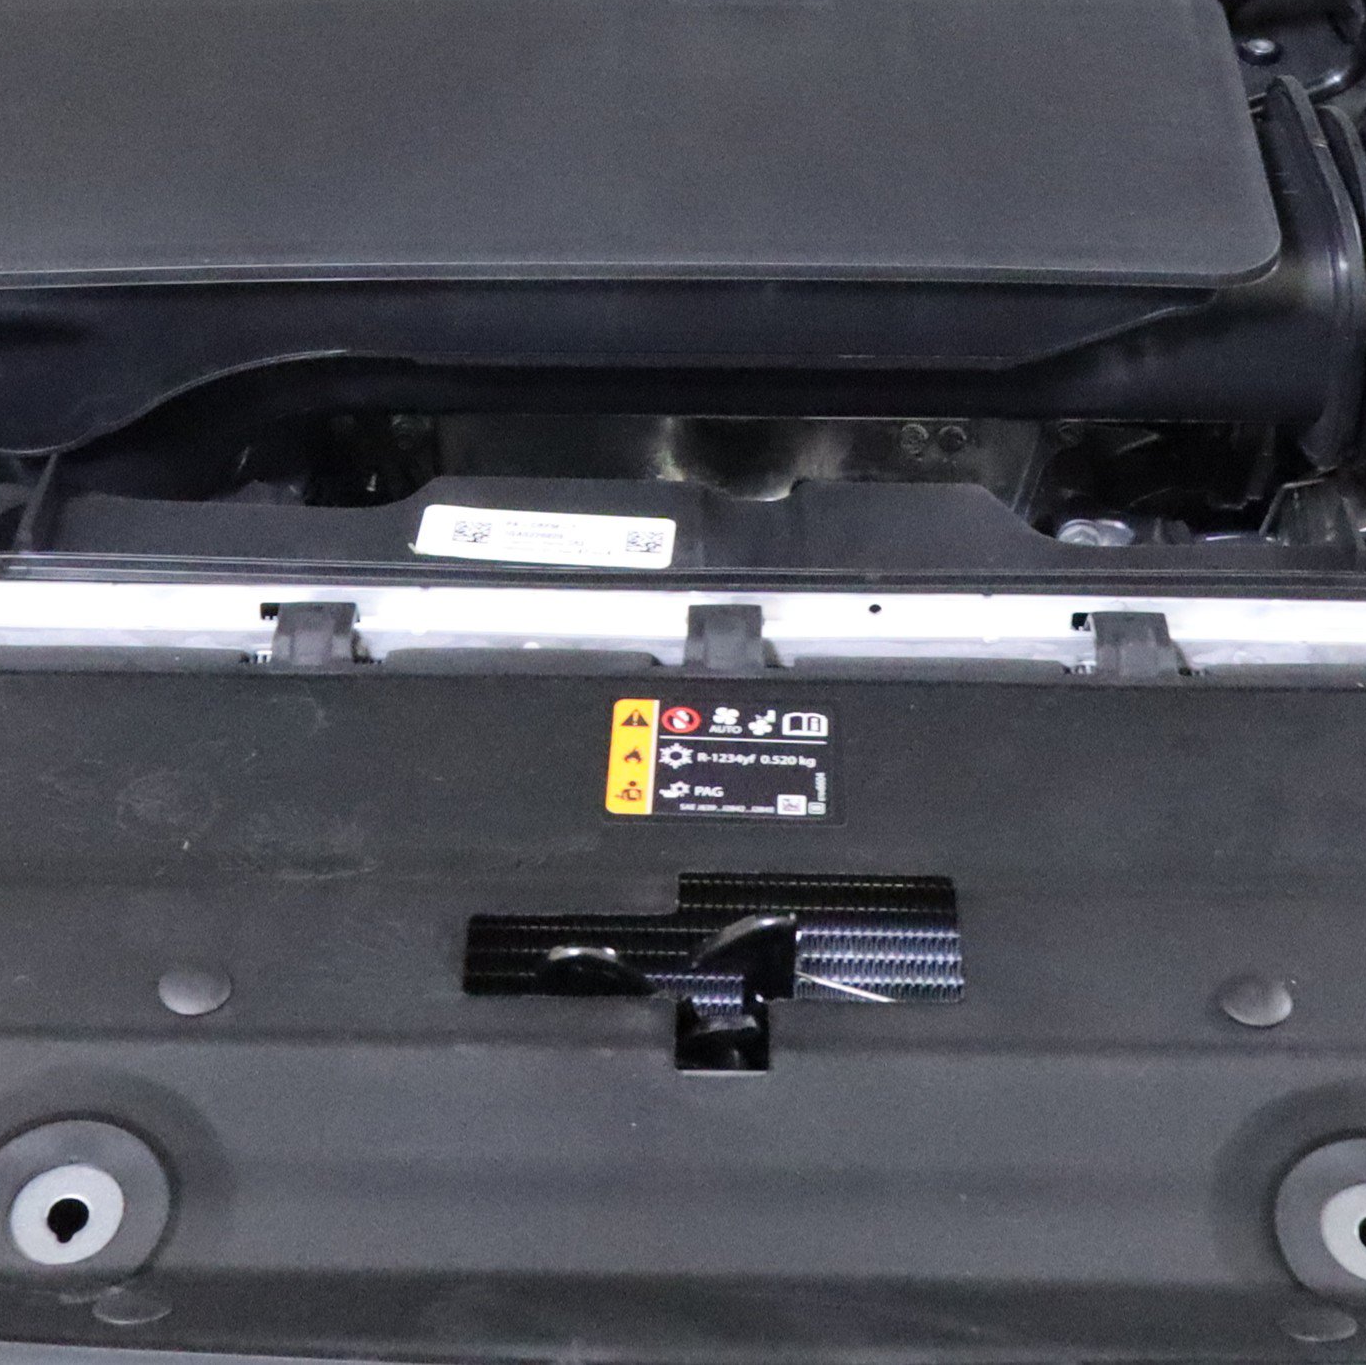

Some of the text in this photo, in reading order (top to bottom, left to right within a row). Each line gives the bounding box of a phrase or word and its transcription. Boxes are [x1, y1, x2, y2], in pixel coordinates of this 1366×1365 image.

[709, 725, 742, 735] AUTO
[697, 753, 817, 768] R-1234yf 0.520 kg
[694, 786, 724, 798] PAG
